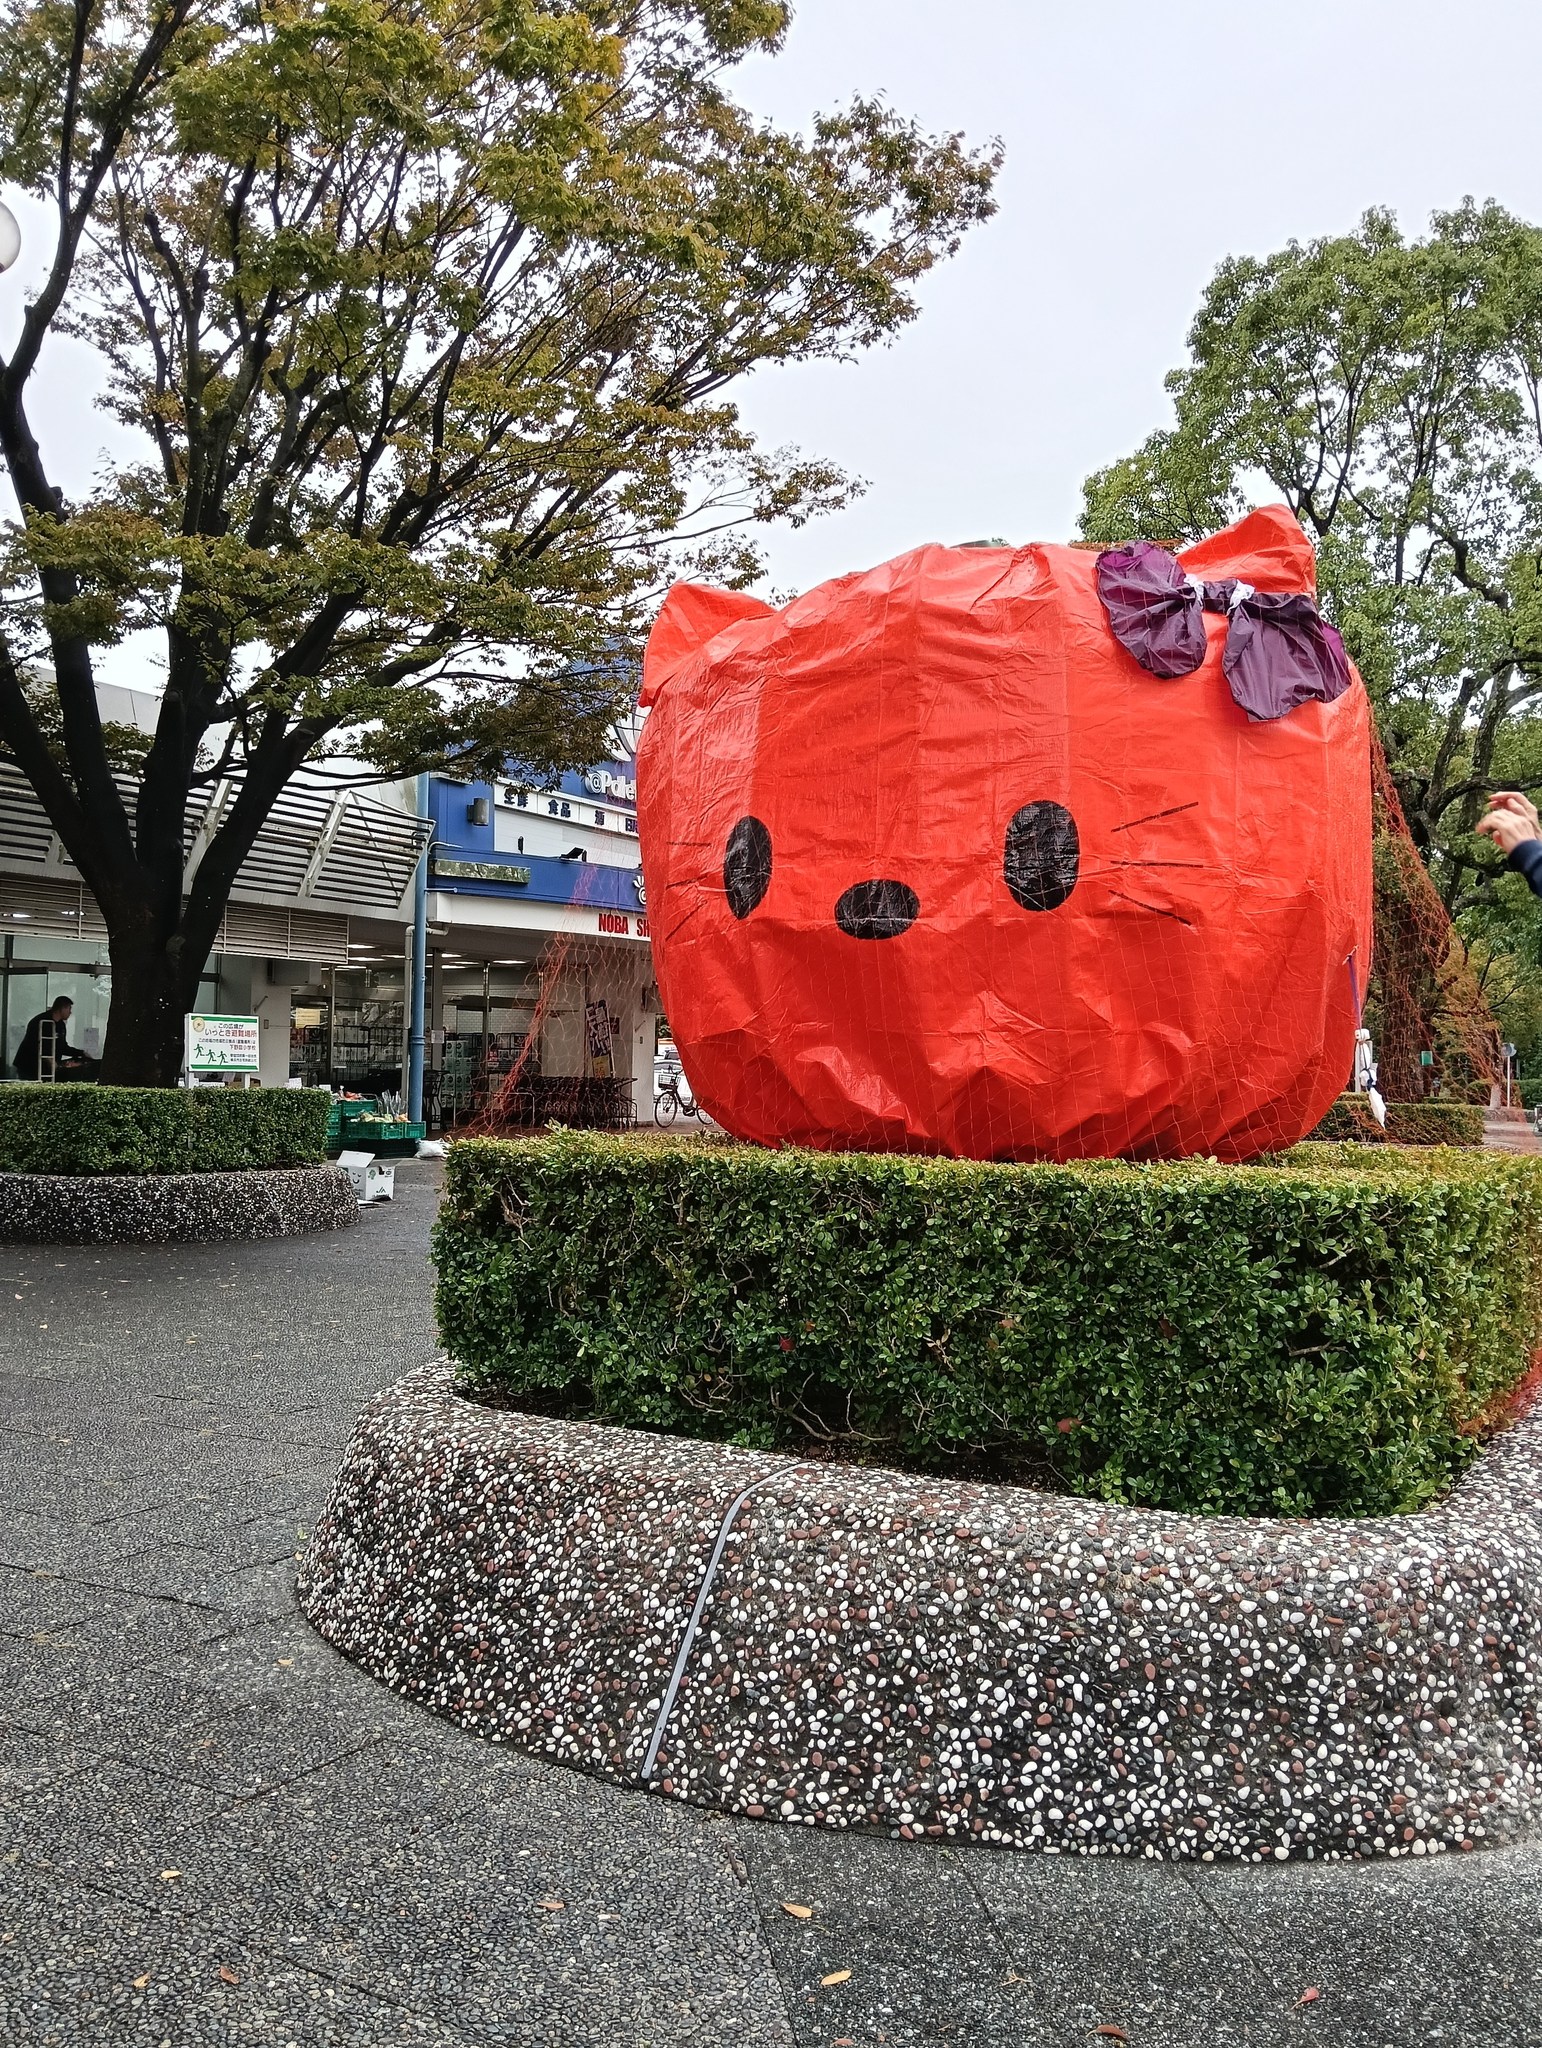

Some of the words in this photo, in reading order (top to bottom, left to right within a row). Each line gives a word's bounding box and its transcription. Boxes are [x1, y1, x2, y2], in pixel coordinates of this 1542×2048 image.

[548, 799, 571, 818] 食品
[594, 809, 606, 826] 酒
[598, 912, 629, 935] NOBA
